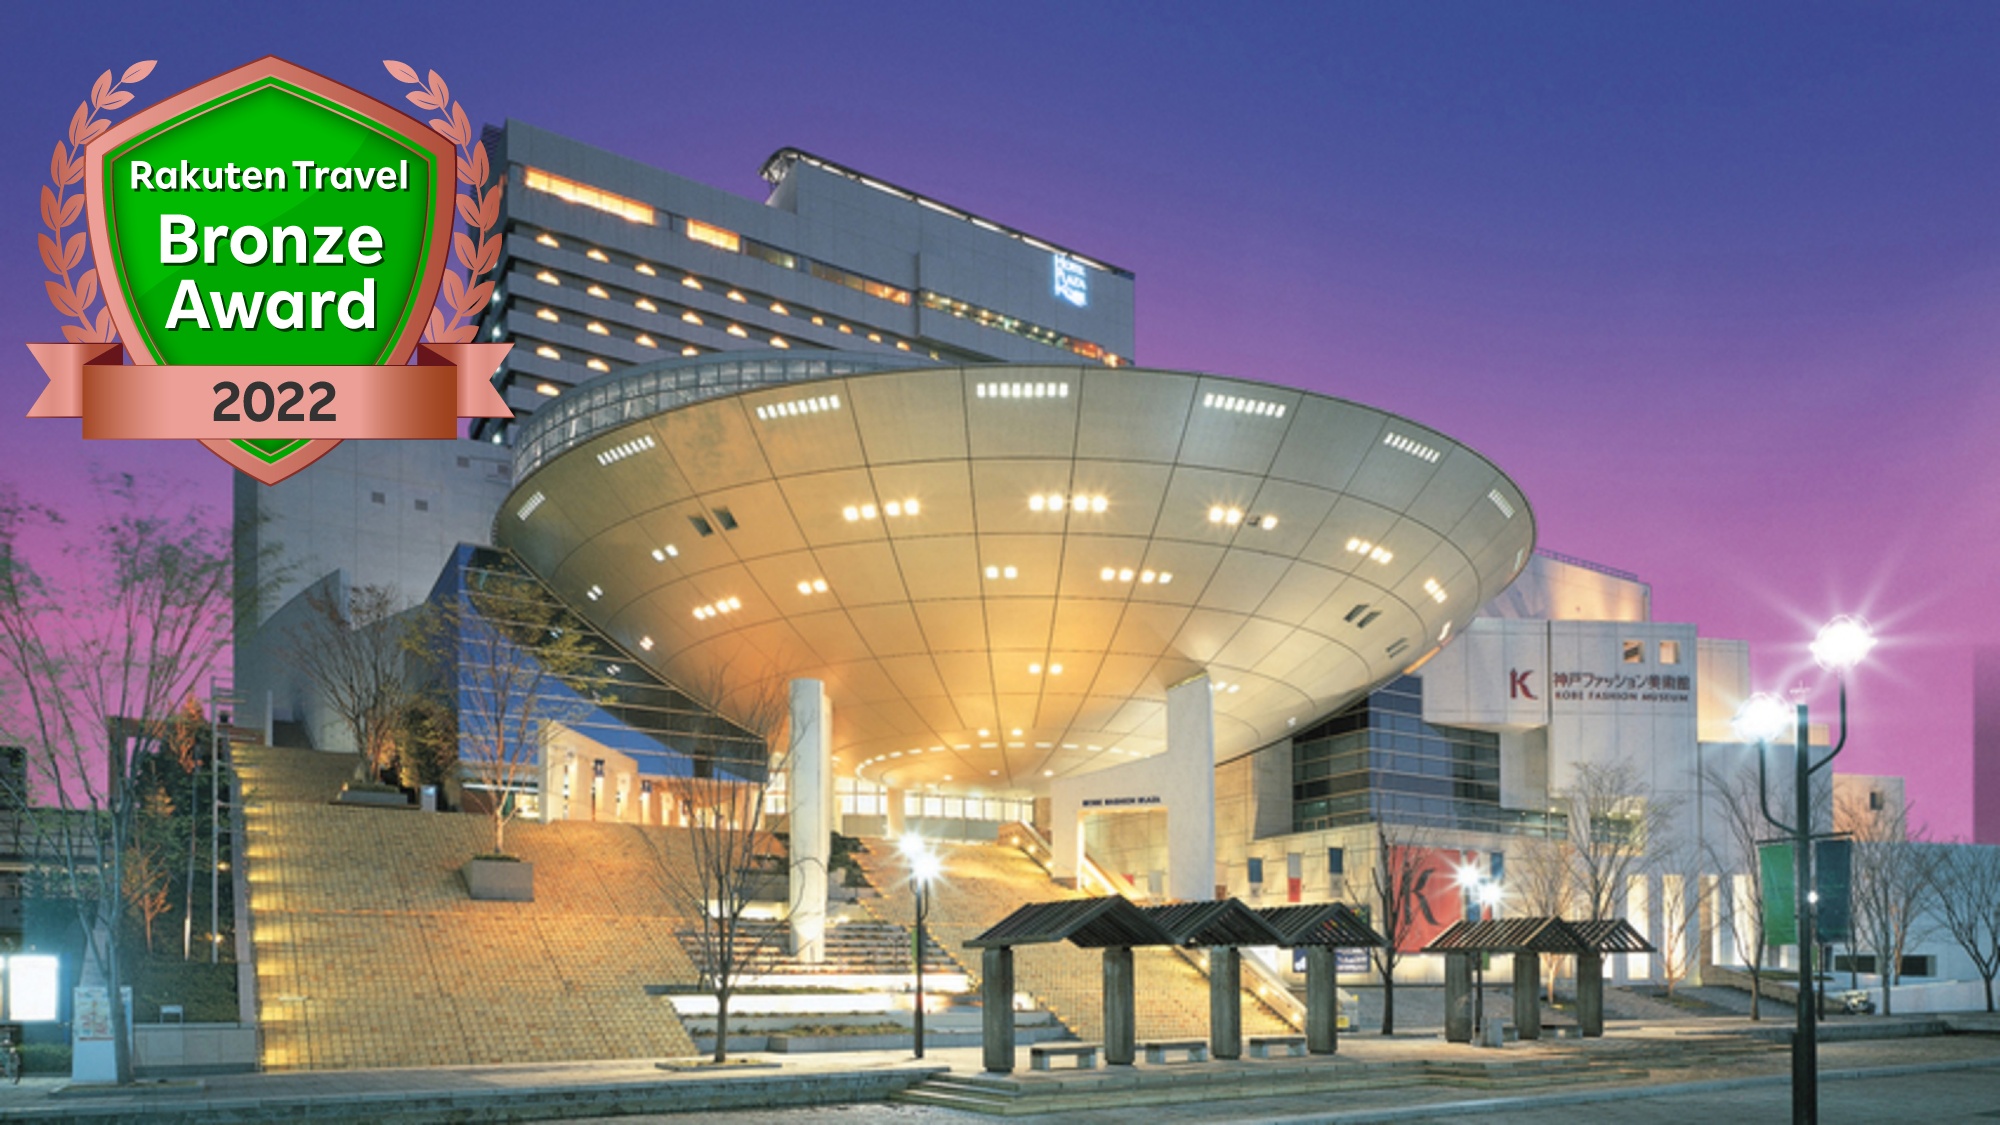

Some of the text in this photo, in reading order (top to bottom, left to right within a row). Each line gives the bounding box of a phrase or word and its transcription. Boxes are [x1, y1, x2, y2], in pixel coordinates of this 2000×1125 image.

[1509, 668, 1538, 700] K
[1553, 672, 1691, 691] 神戸ファッション美術館
[1554, 691, 1689, 702] KOBE FASHION MUSEUM
[1402, 867, 1441, 927] K
